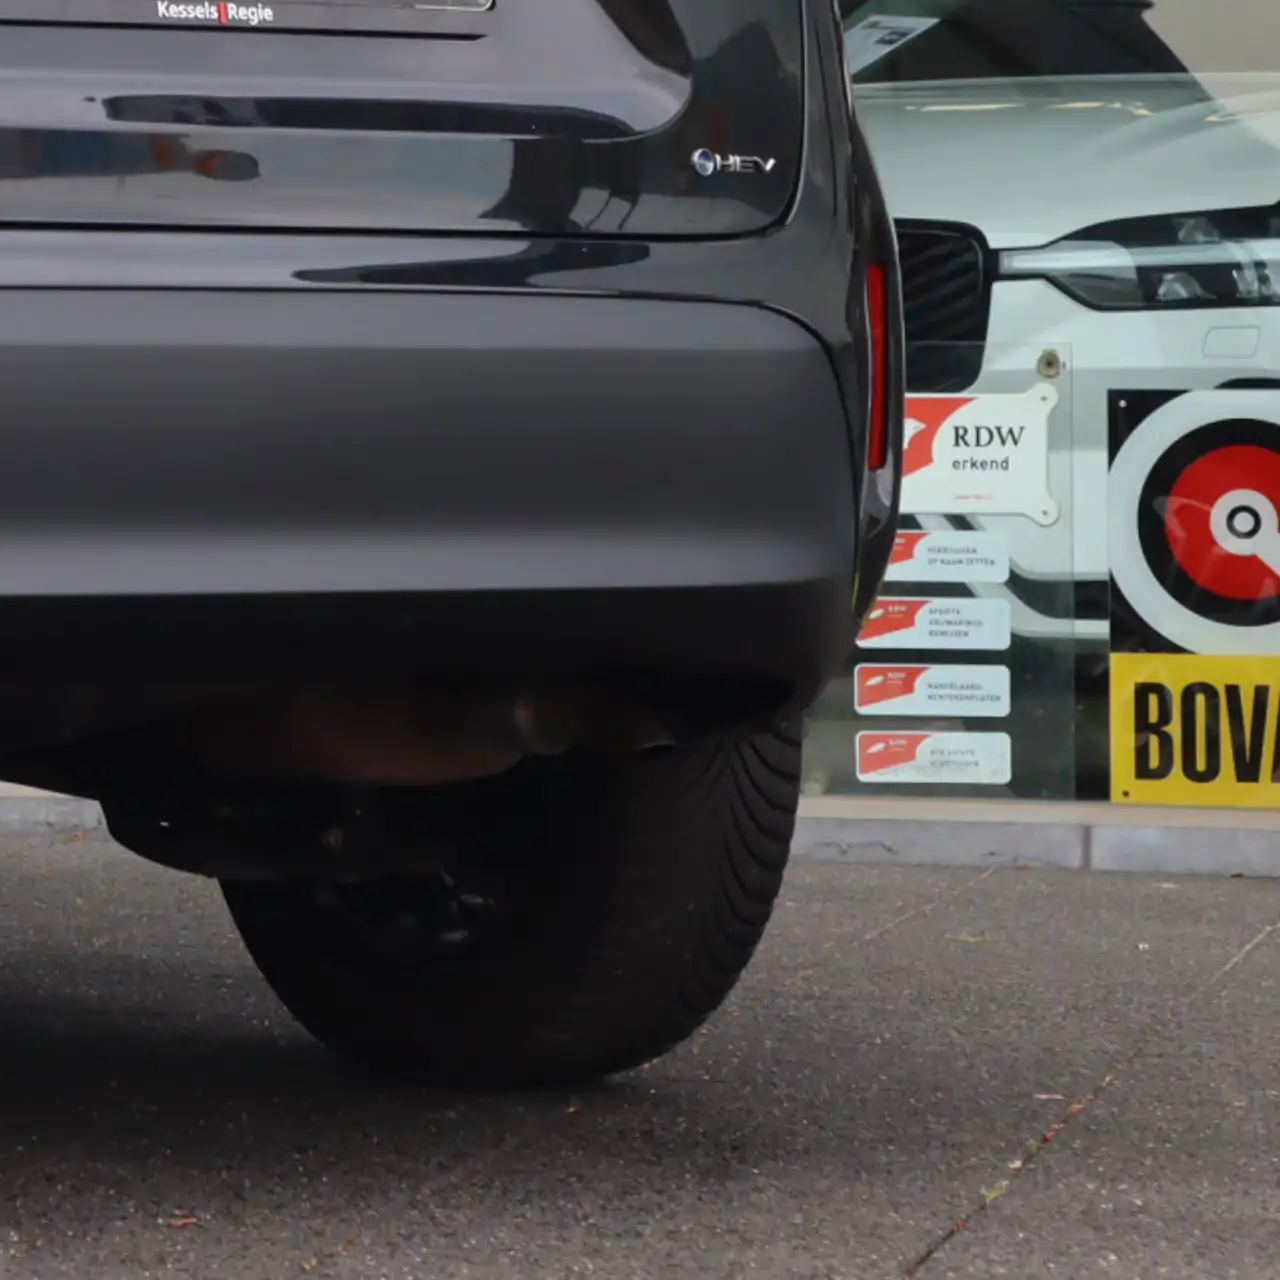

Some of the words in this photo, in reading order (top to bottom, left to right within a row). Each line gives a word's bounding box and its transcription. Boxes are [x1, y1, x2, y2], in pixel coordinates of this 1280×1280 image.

[156, 0, 219, 21] Kessels
[226, 1, 274, 26] Regie
[714, 152, 776, 173] HEV
[953, 425, 1026, 448] RDW
[951, 455, 1010, 473] erkend
[1133, 680, 1280, 784] BOV
